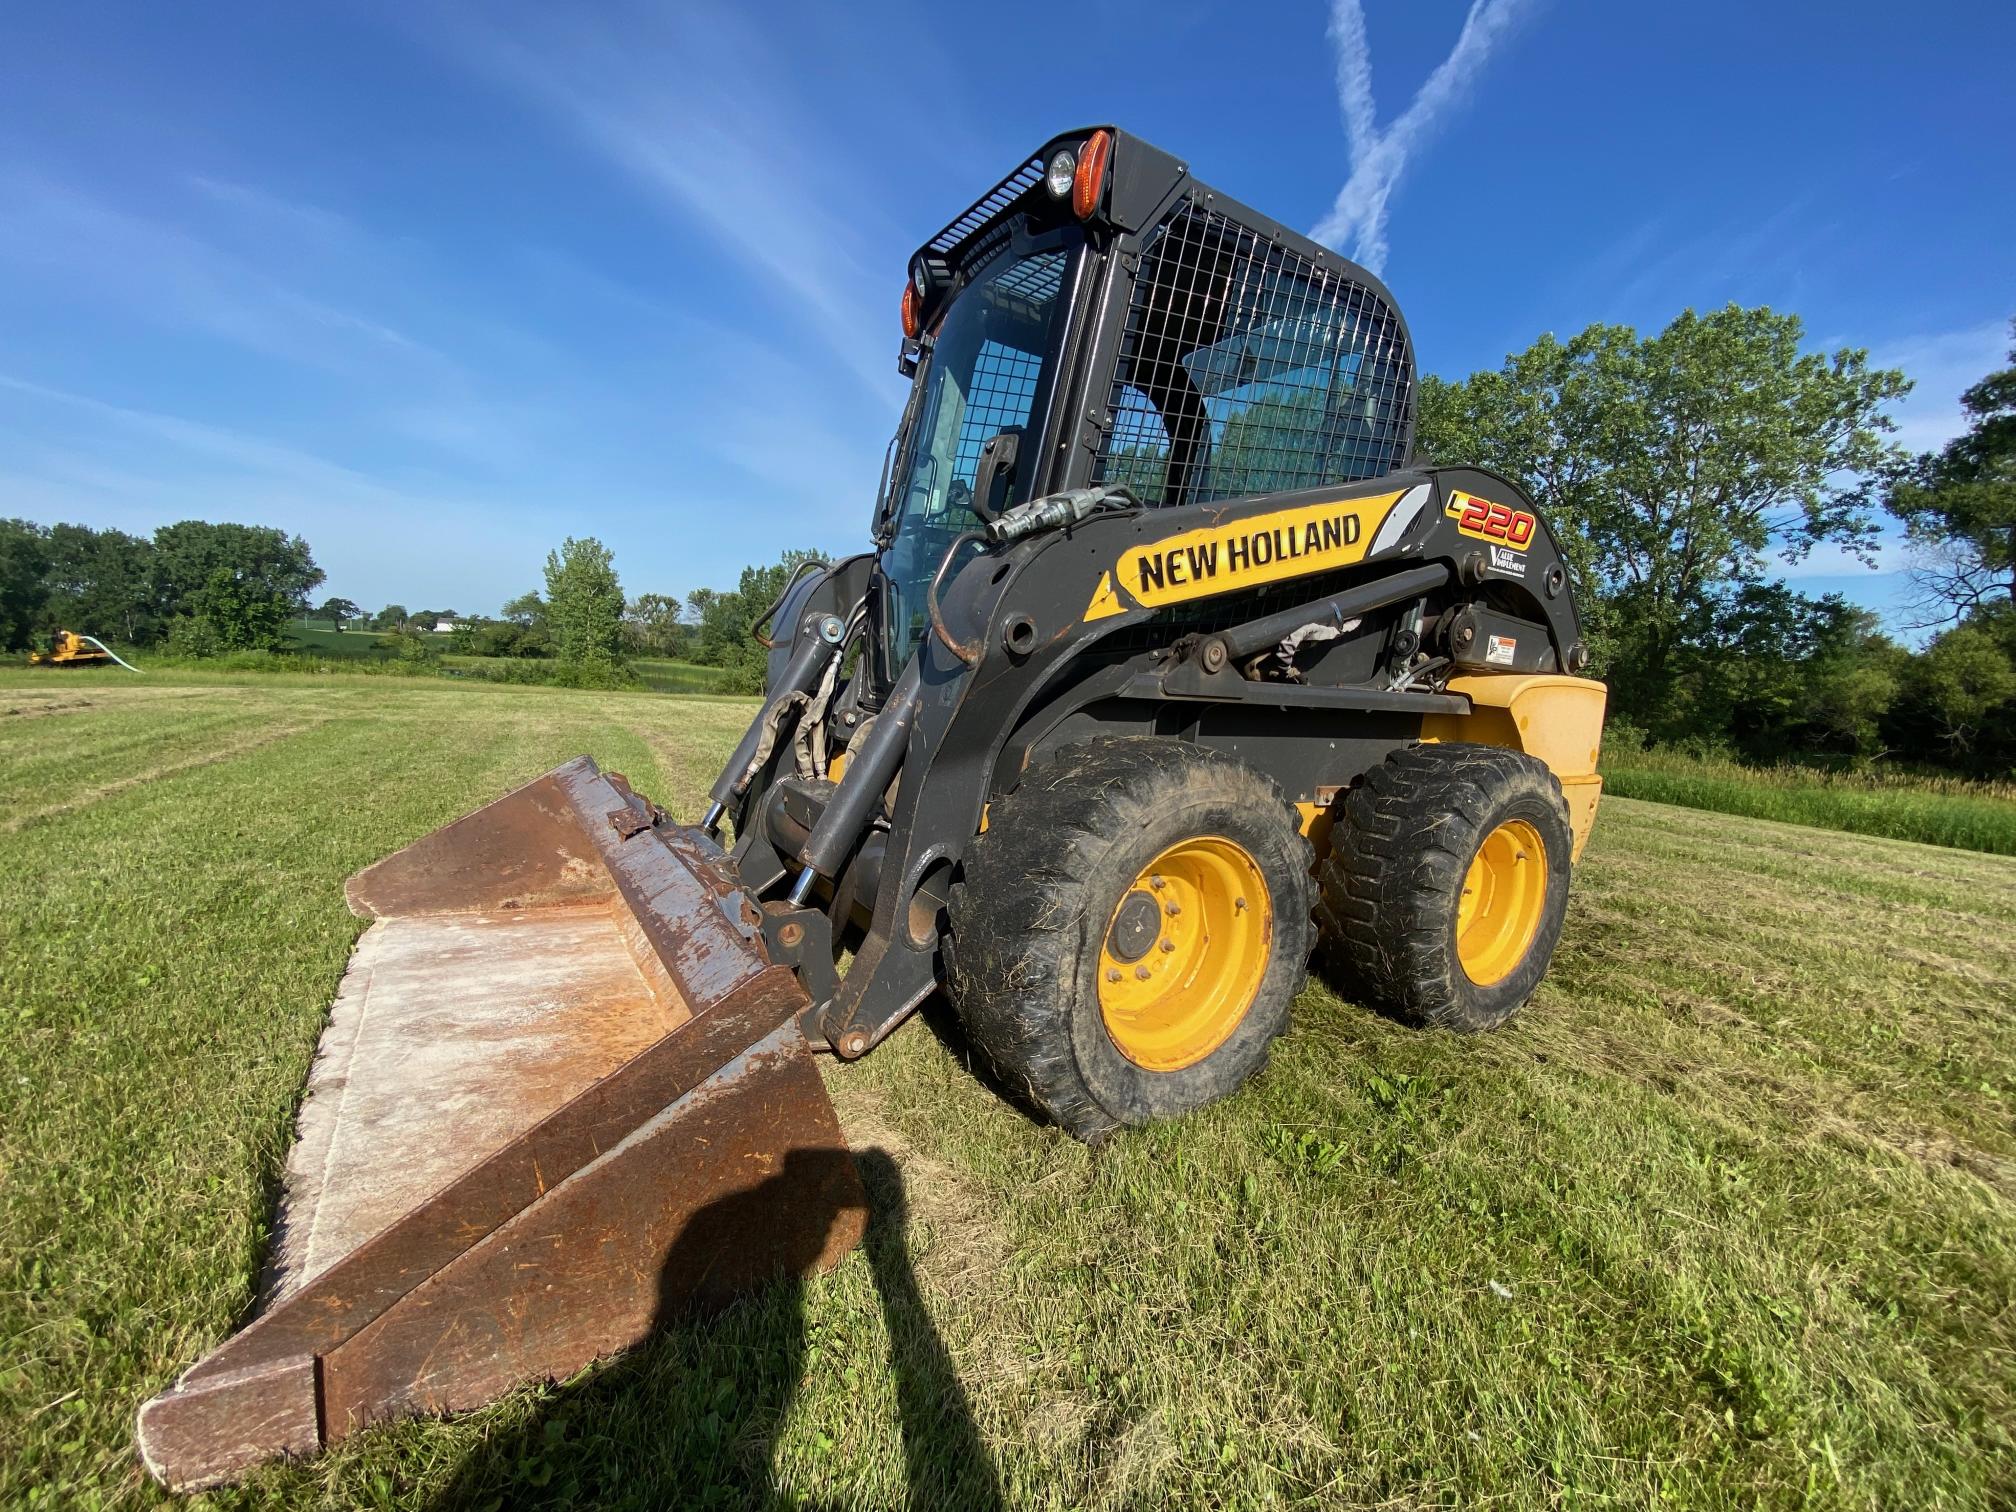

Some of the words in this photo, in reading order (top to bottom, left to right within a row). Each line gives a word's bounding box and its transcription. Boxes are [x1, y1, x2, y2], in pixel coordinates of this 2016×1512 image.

[1447, 493, 1534, 545] L220
[1138, 542, 1217, 592] NEW
[1227, 513, 1361, 572] HOLLAND
